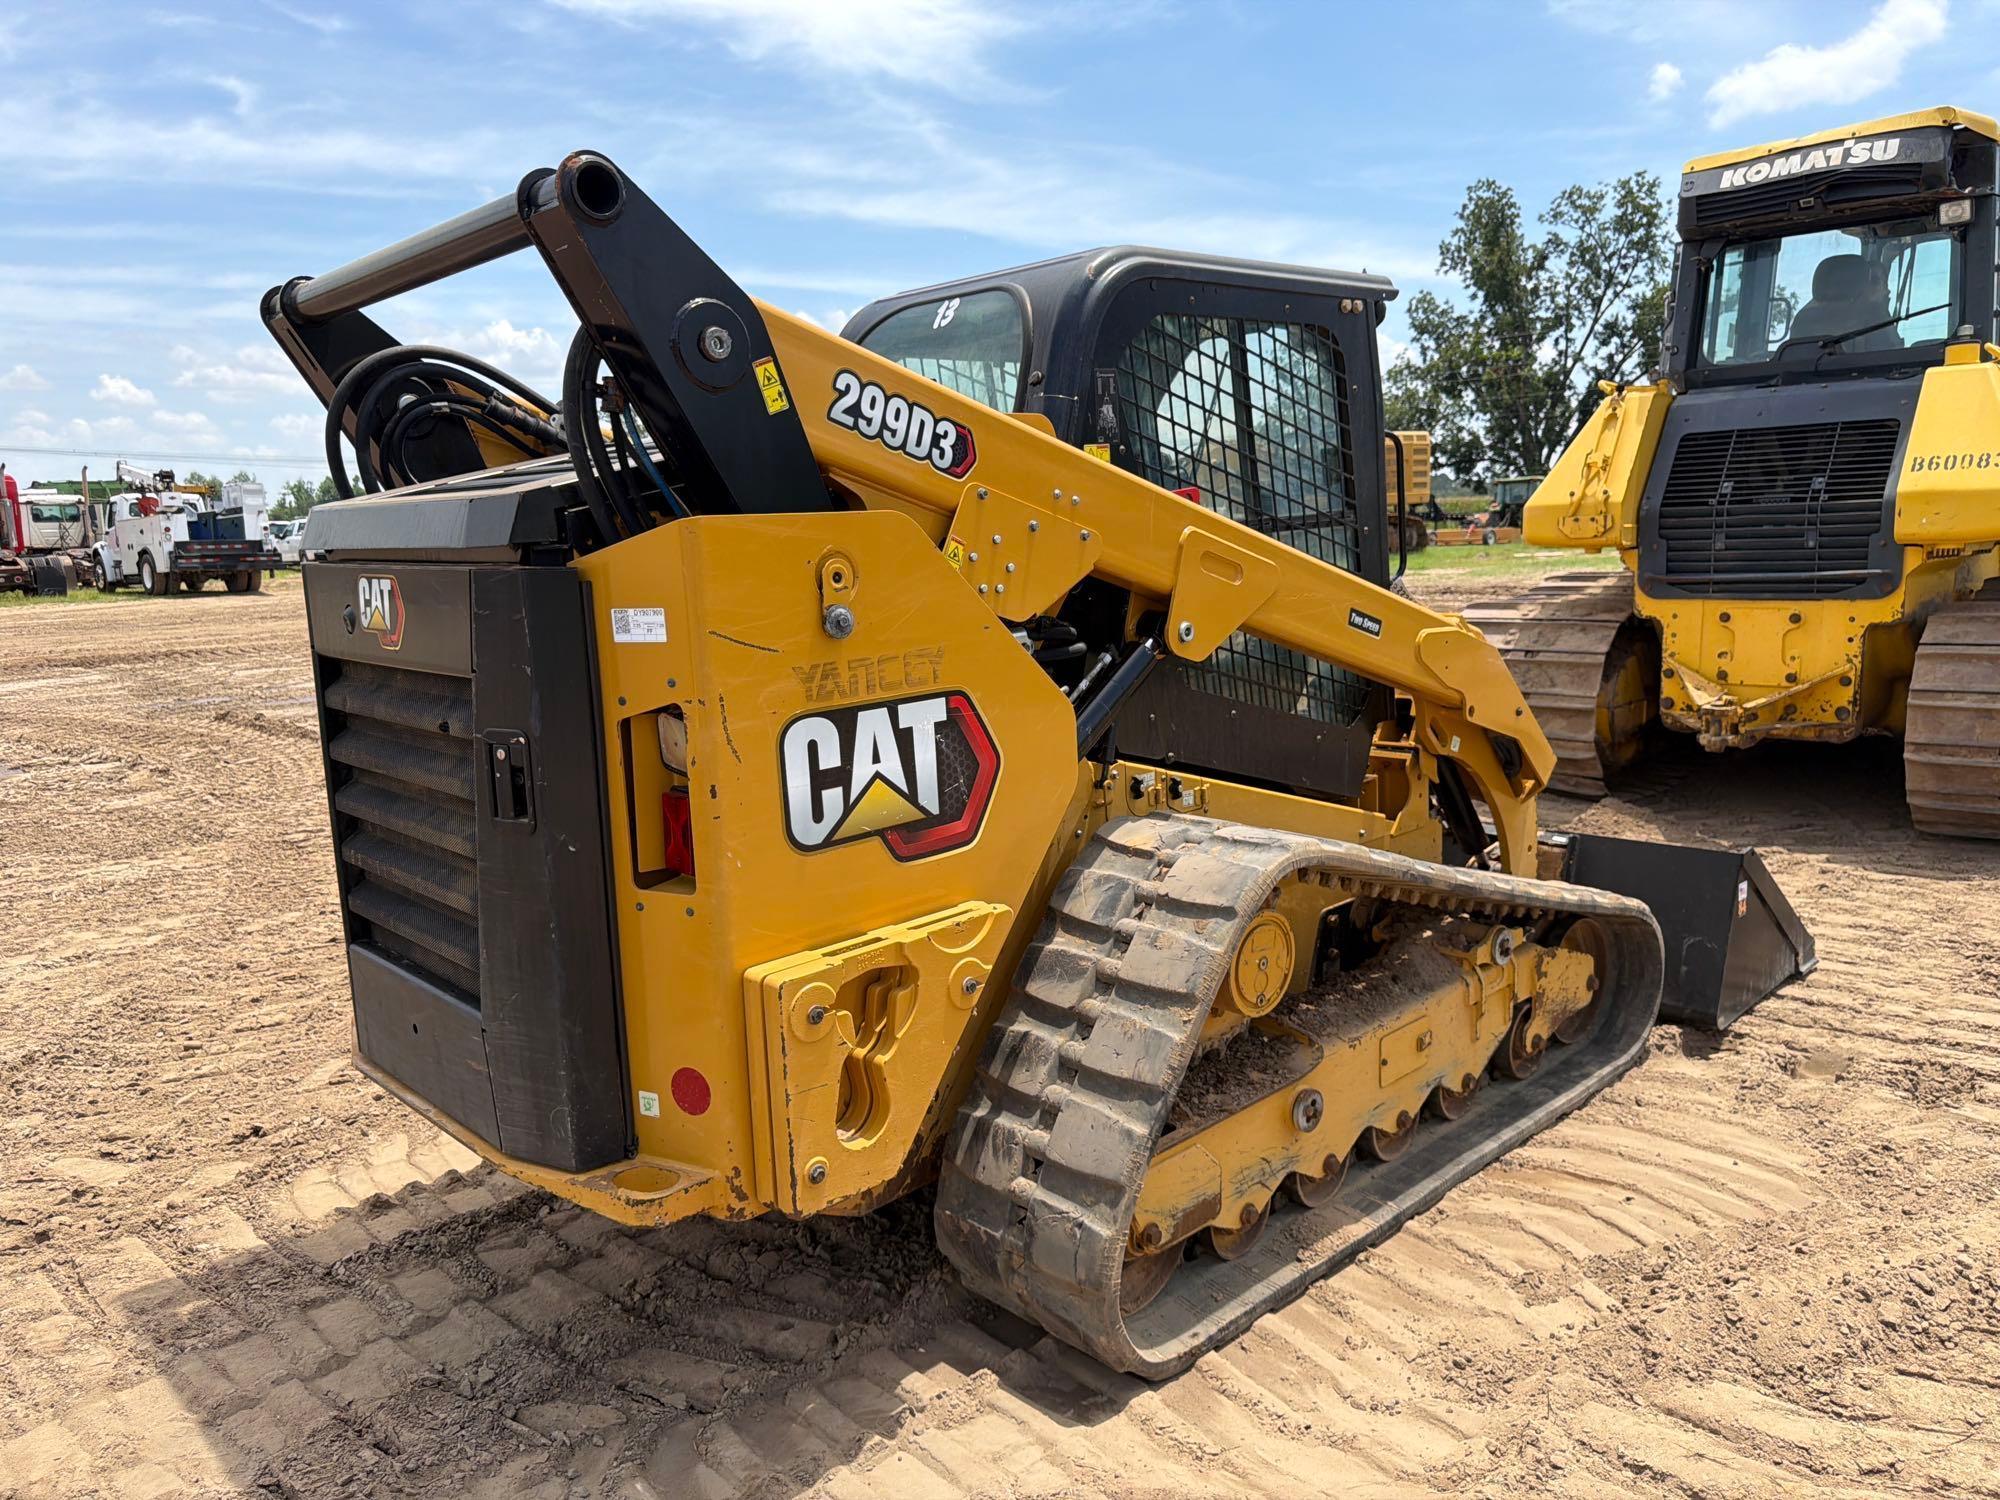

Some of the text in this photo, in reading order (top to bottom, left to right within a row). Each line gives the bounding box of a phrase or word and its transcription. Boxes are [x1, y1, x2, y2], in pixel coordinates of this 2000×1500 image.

[1720, 138, 1900, 189] KOMATSU
[932, 297, 960, 329] 13
[828, 370, 958, 470] 299D3
[358, 576, 392, 630] CAT
[783, 696, 948, 846] CAT
